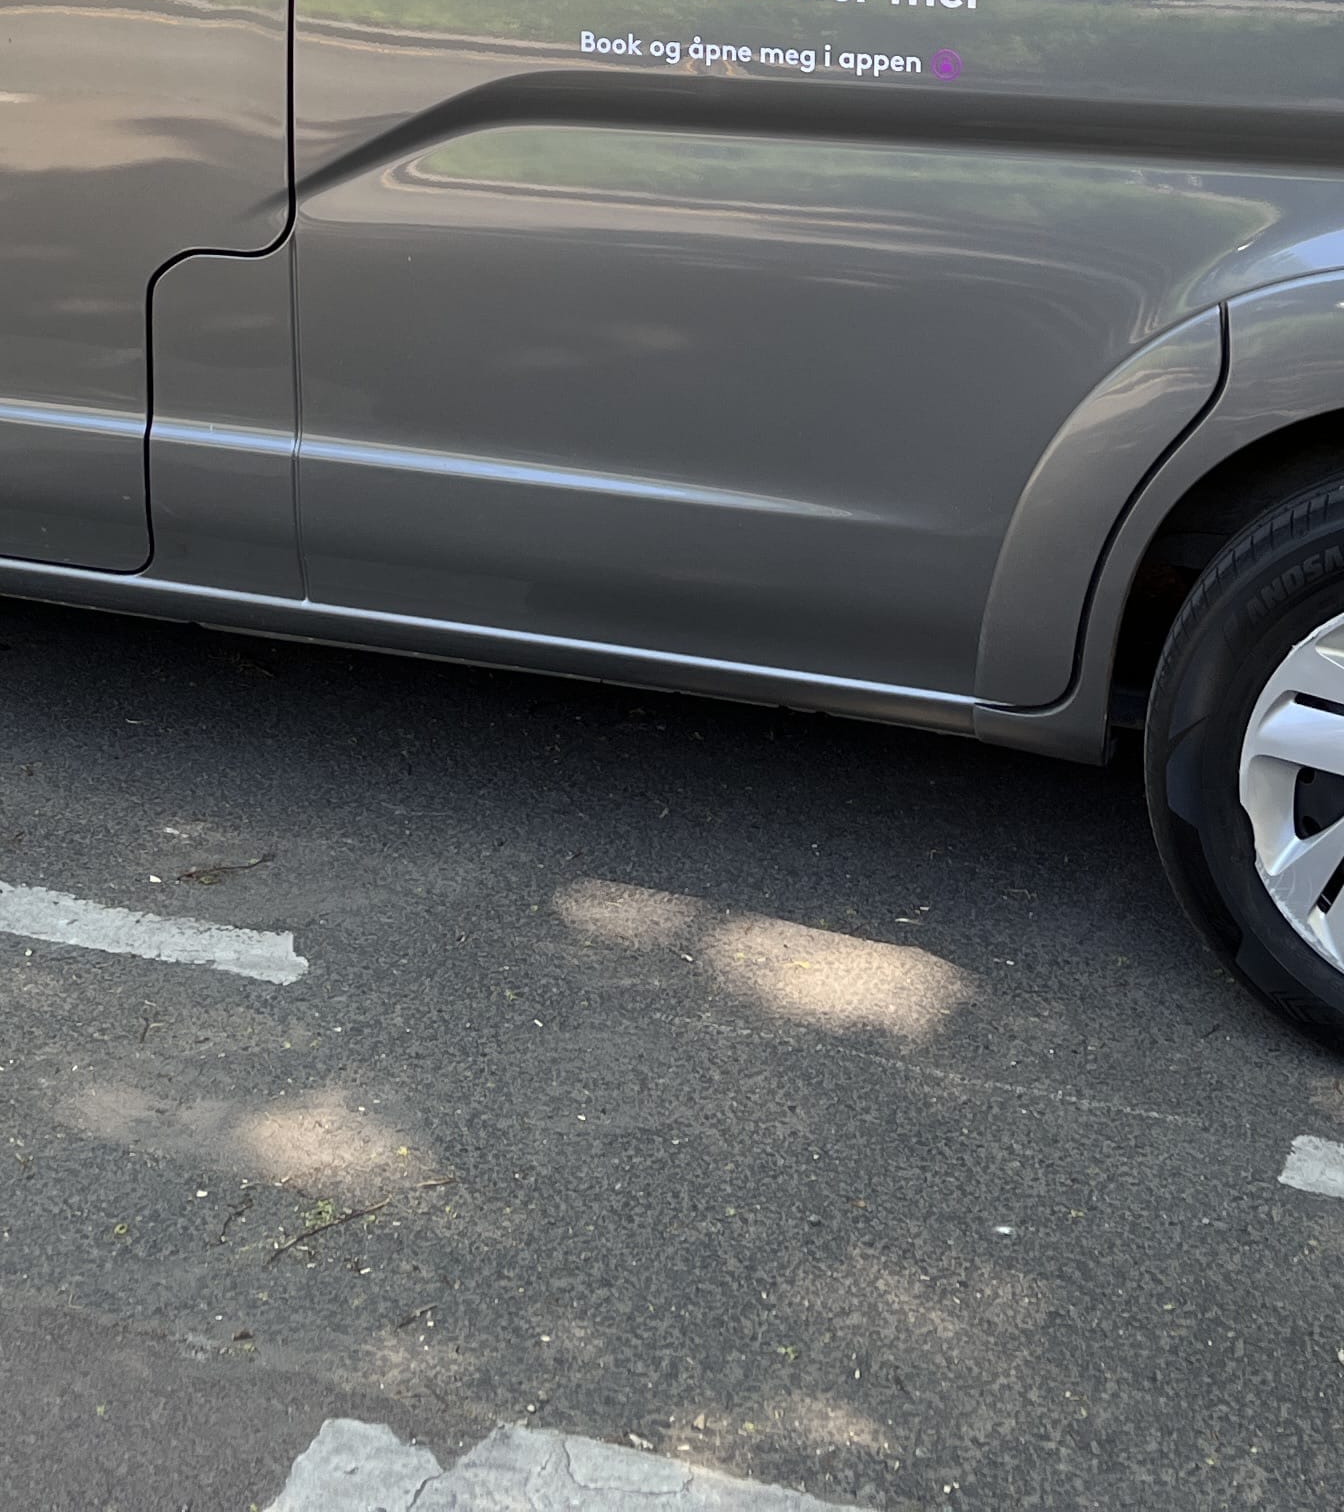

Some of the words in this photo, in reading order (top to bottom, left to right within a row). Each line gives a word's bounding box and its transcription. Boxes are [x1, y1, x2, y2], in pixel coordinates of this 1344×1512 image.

[580, 30, 643, 57] Book
[649, 39, 682, 65] og
[688, 36, 753, 67] åpne
[759, 46, 816, 72] meg
[823, 44, 833, 68] i
[838, 49, 923, 77] appen
